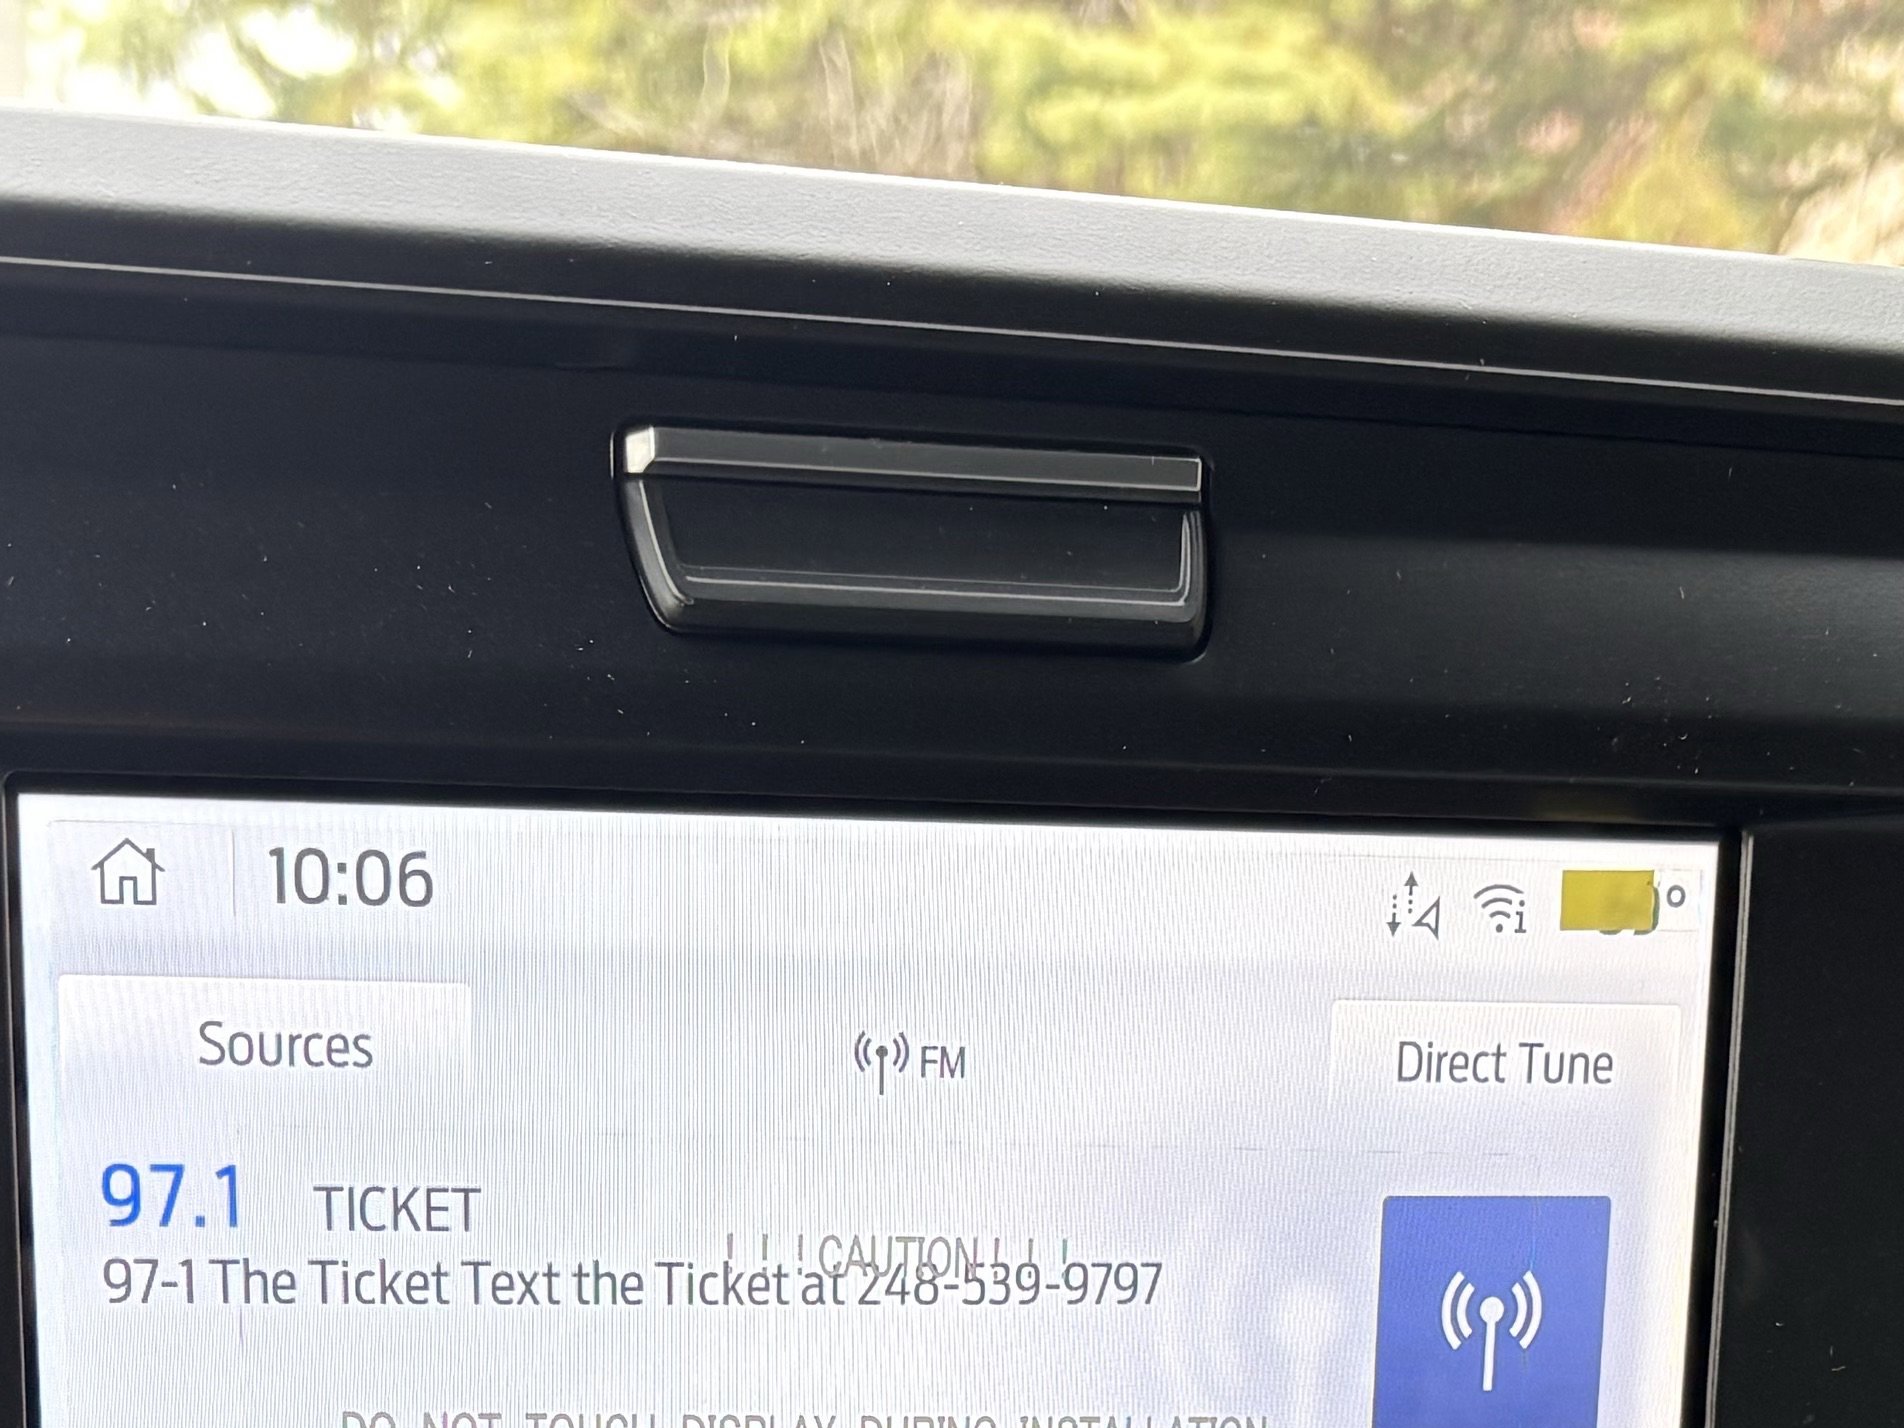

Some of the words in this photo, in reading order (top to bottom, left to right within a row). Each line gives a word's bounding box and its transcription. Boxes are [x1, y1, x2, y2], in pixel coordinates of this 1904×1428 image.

[269, 847, 434, 908] 10:06
[198, 1020, 374, 1068] Sources
[921, 1047, 966, 1080] FM
[1397, 1040, 1506, 1086] Direct
[1519, 1041, 1614, 1086] Tune
[101, 1164, 240, 1229] 97.1
[314, 1186, 482, 1232] TICKET
[819, 1234, 979, 1279] CAUTION
[103, 1258, 195, 1306] 97-1
[208, 1258, 297, 1306] The
[307, 1259, 450, 1306] Ticket
[462, 1259, 561, 1306] Text
[572, 1259, 644, 1306] the
[655, 1259, 791, 1306] Ticket
[801, 1264, 846, 1306] at
[858, 1261, 1164, 1306] 248-539-9797
